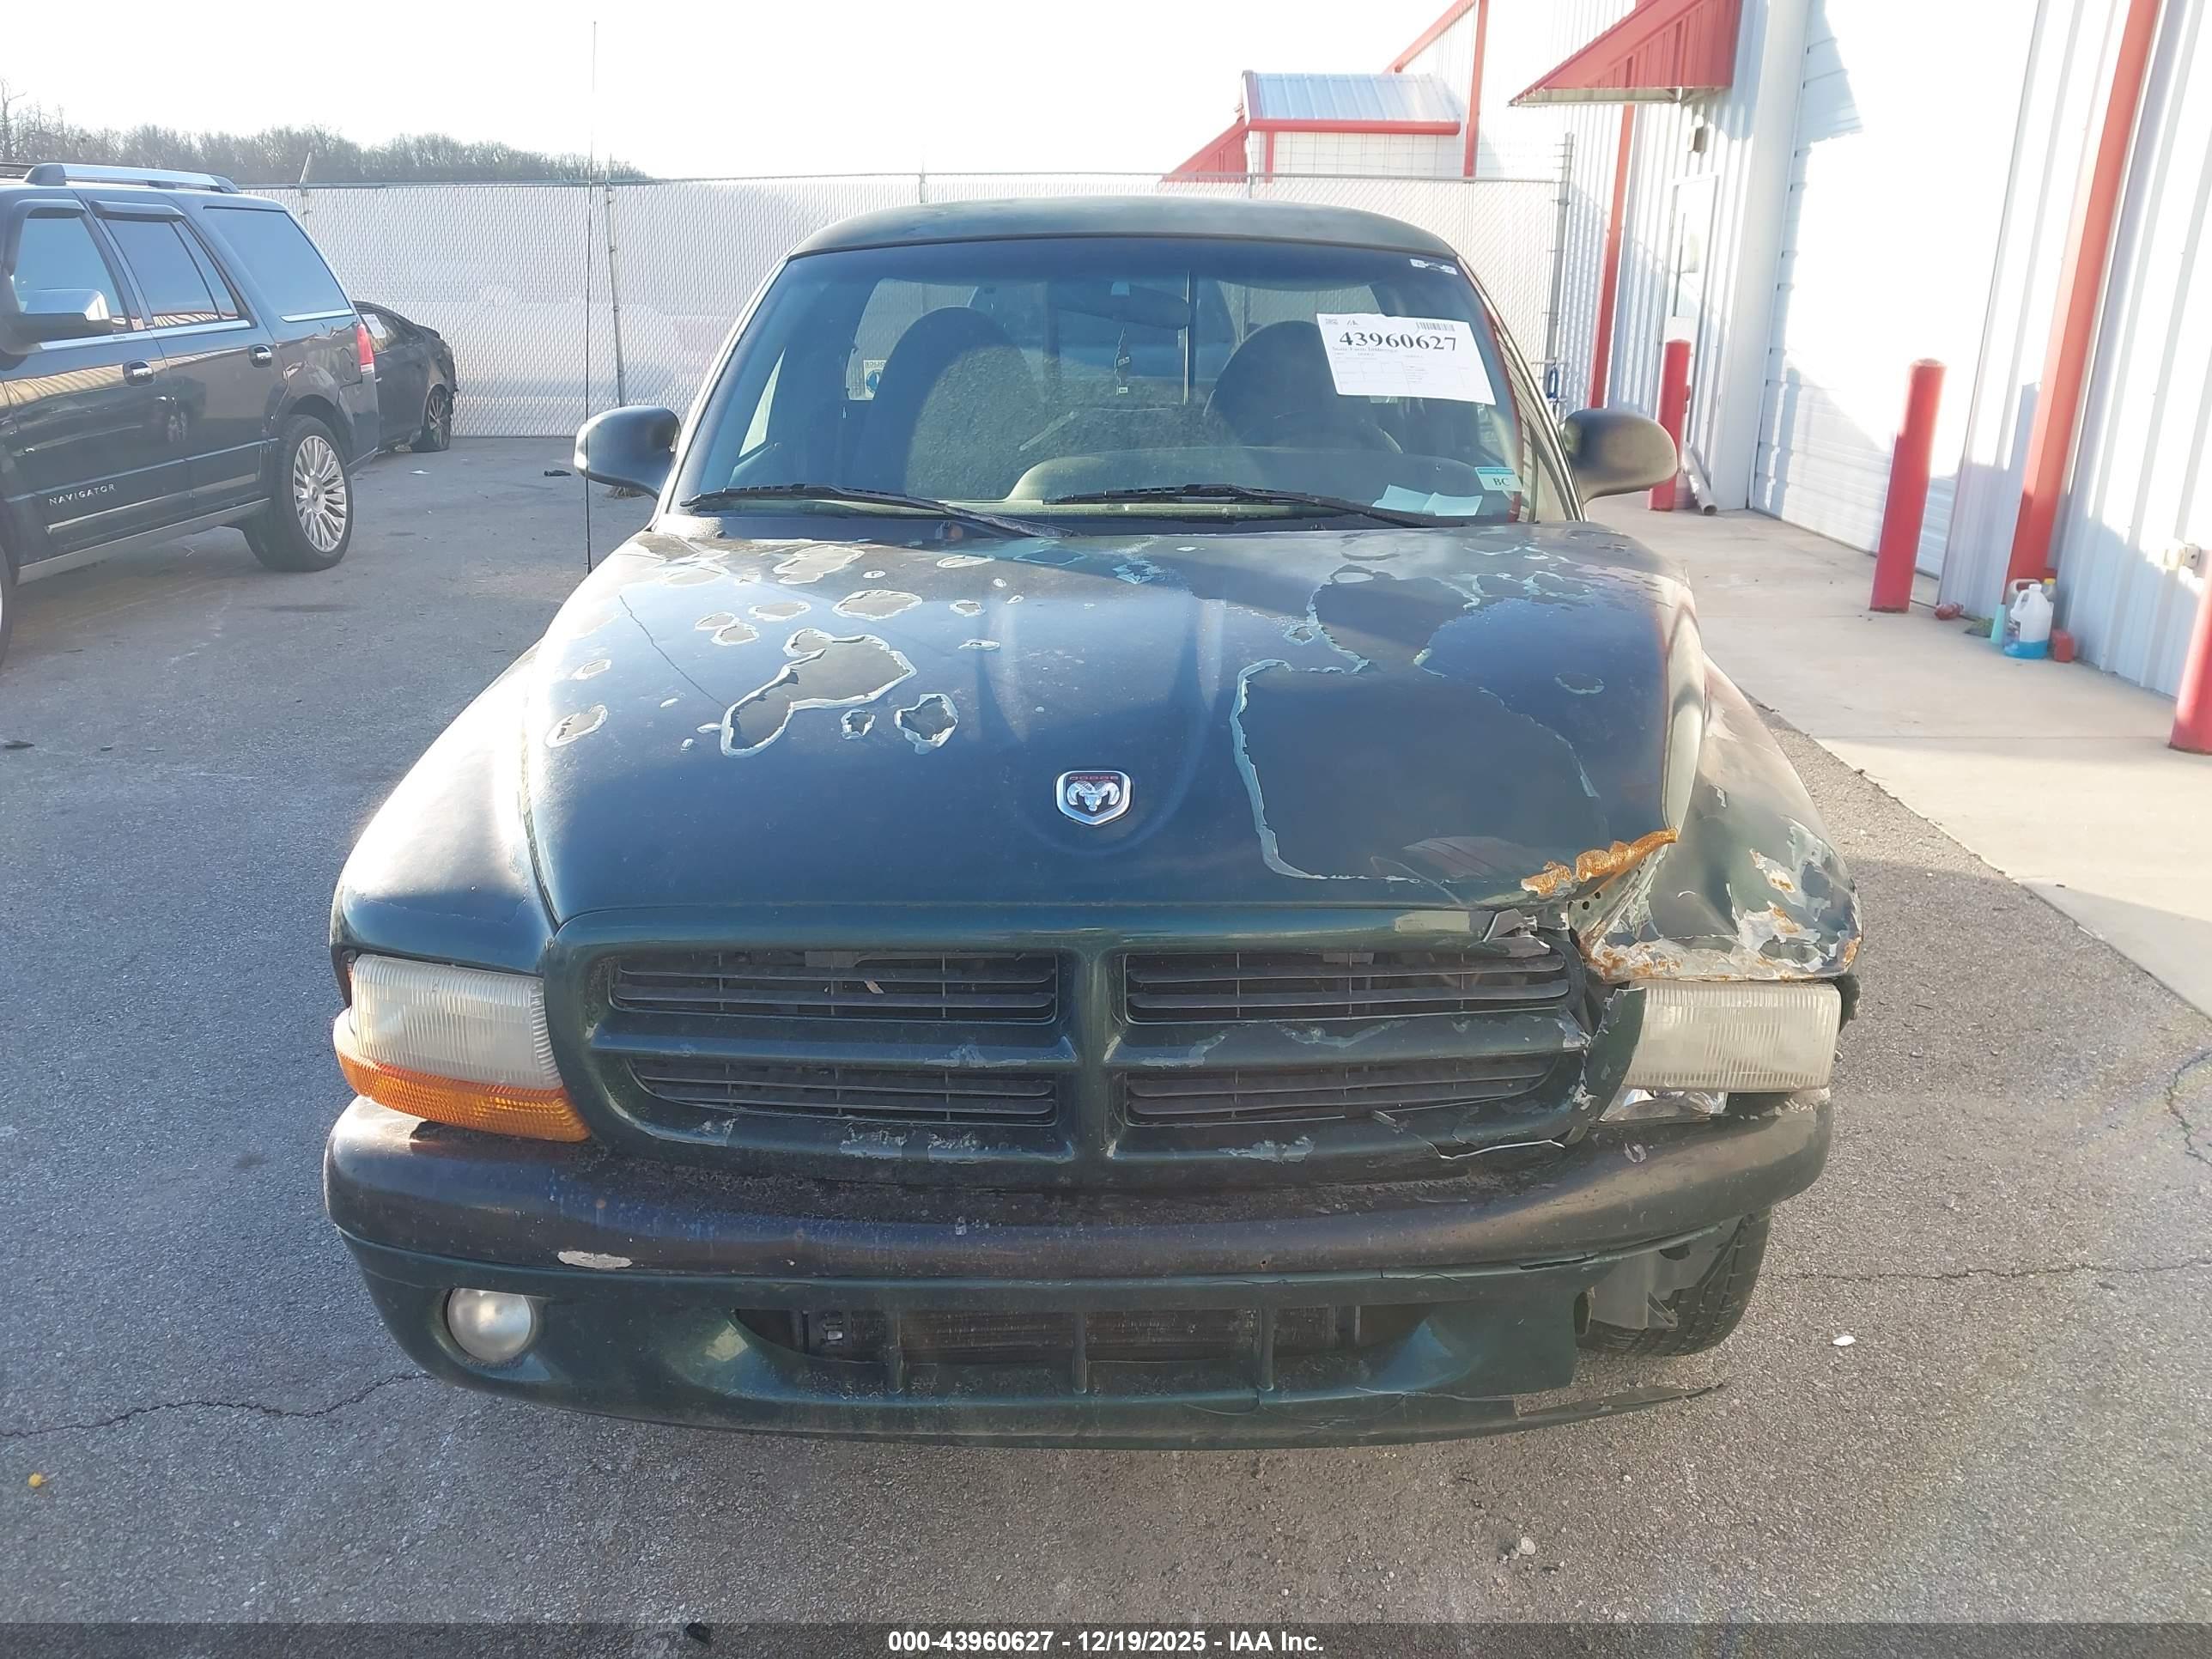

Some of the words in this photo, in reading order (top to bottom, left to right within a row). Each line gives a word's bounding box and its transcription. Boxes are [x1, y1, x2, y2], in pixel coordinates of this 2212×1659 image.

[1340, 331, 1457, 351] 43960627
[1492, 477, 1511, 487] BC
[49, 483, 115, 506] NAVIGATOR
